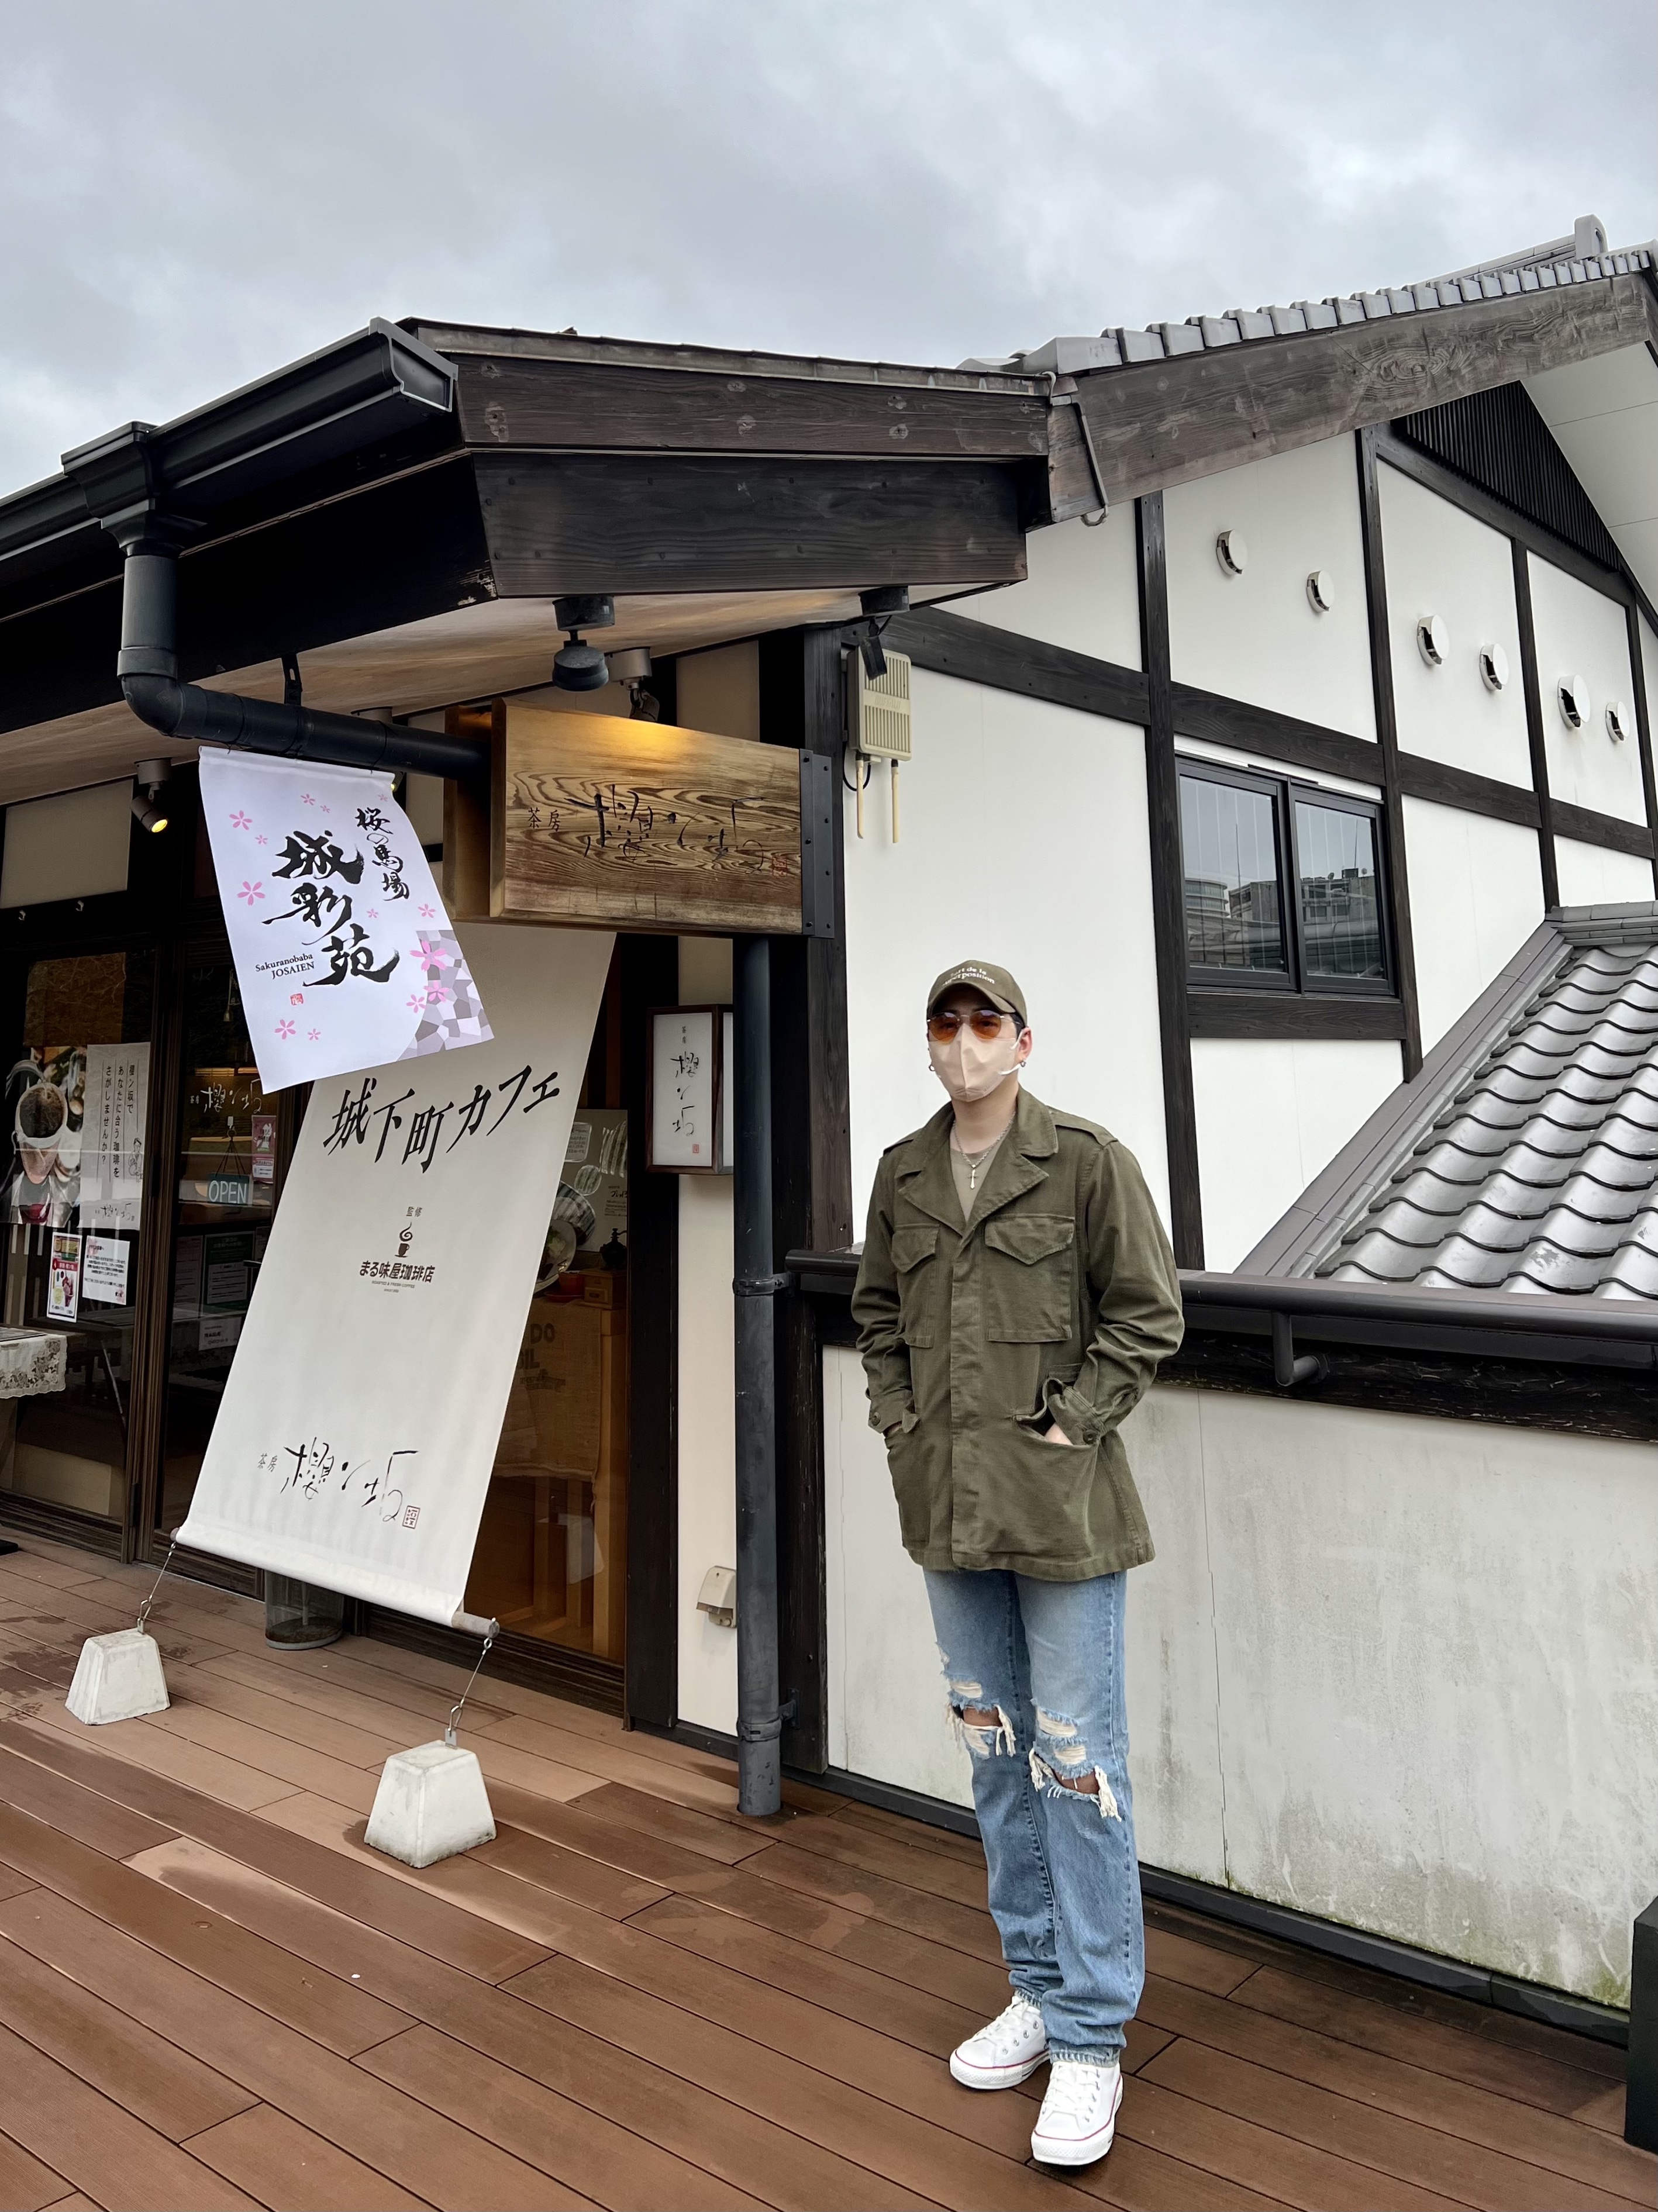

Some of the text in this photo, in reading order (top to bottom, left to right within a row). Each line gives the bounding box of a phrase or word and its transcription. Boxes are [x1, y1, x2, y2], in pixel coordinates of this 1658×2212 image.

[528, 807, 561, 832] 茶房
[355, 807, 410, 902] 桜の馬場
[262, 830, 399, 987] 城彩苑
[256, 953, 313, 972] Sakuranobaba
[271, 961, 315, 979] JOSAIEN
[113, 1065, 124, 1178] あなたに合う珈琲を
[323, 1065, 560, 1174] 城下町カフェ
[208, 1180, 247, 1204] OPEN
[406, 1206, 423, 1217] 監修
[360, 1260, 436, 1283] まる味屋珈琲店
[530, 1323, 556, 1344] DO
[257, 1453, 277, 1472] 茶房
